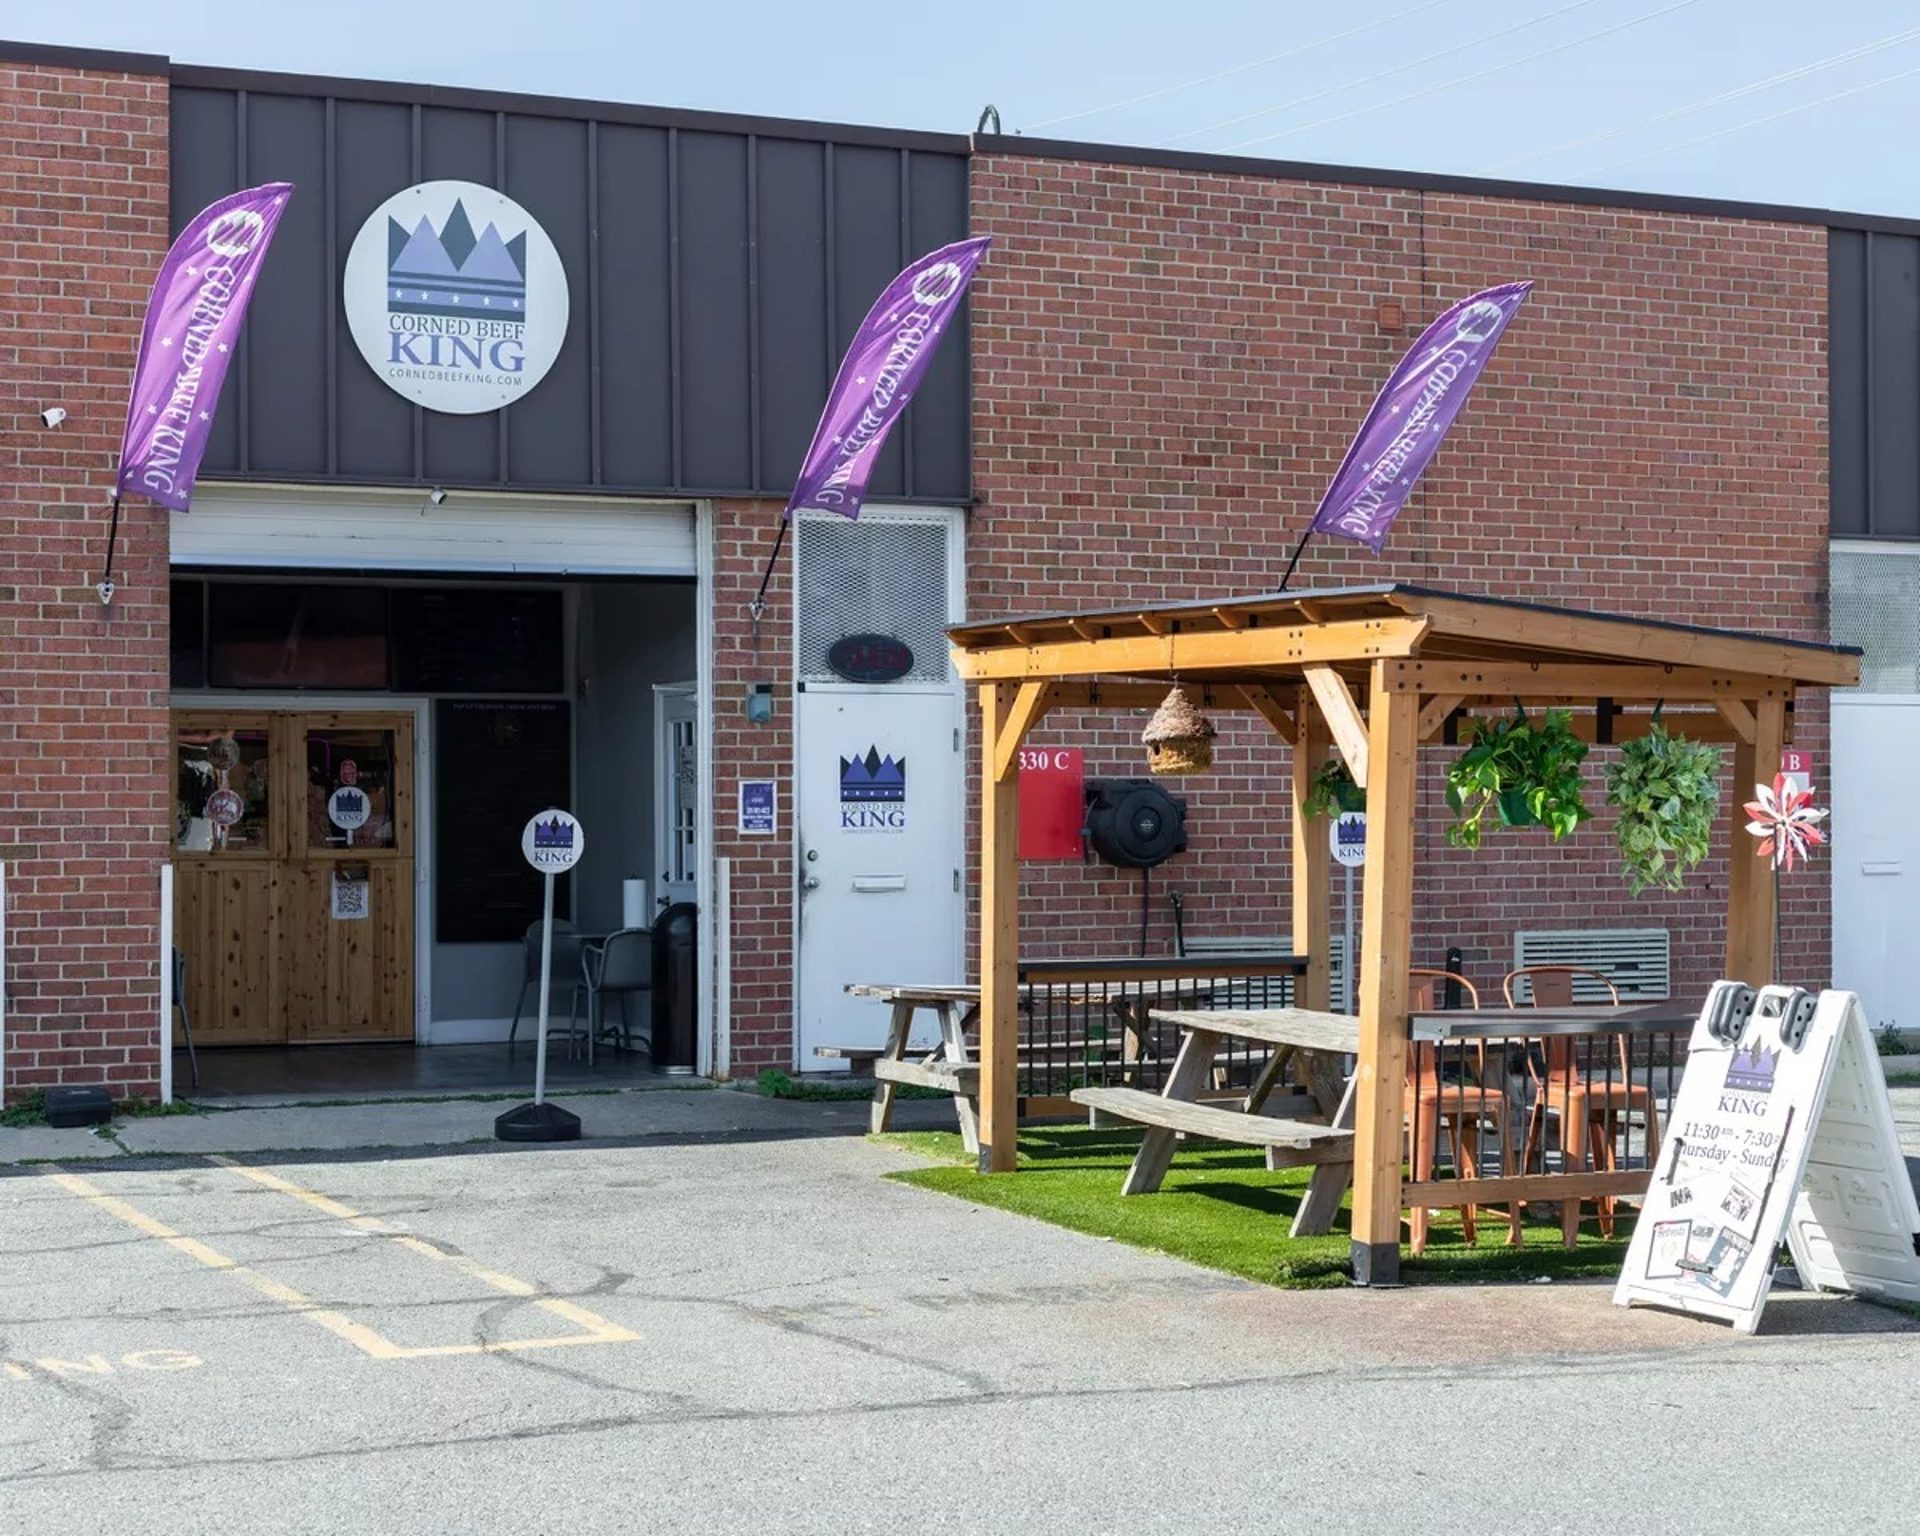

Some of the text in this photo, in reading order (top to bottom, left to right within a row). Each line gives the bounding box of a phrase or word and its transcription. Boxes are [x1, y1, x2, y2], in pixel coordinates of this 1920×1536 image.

[181, 264, 235, 368] CORNED
[389, 314, 526, 339] CORNED BEEF
[386, 331, 526, 372] KING
[389, 367, 523, 386] CORNEDBEEFKING.COM
[143, 423, 187, 495] KING
[1055, 751, 1070, 770] C
[1789, 754, 1801, 770] B
[840, 810, 906, 827] KING
[535, 852, 573, 862] KING
[1718, 1096, 1768, 1117] KING
[1683, 1121, 1721, 1140] 11:30
[1679, 1141, 1731, 1165] hursday
[1740, 1148, 1789, 1174] Sundy
[1, 1348, 205, 1382] ING
